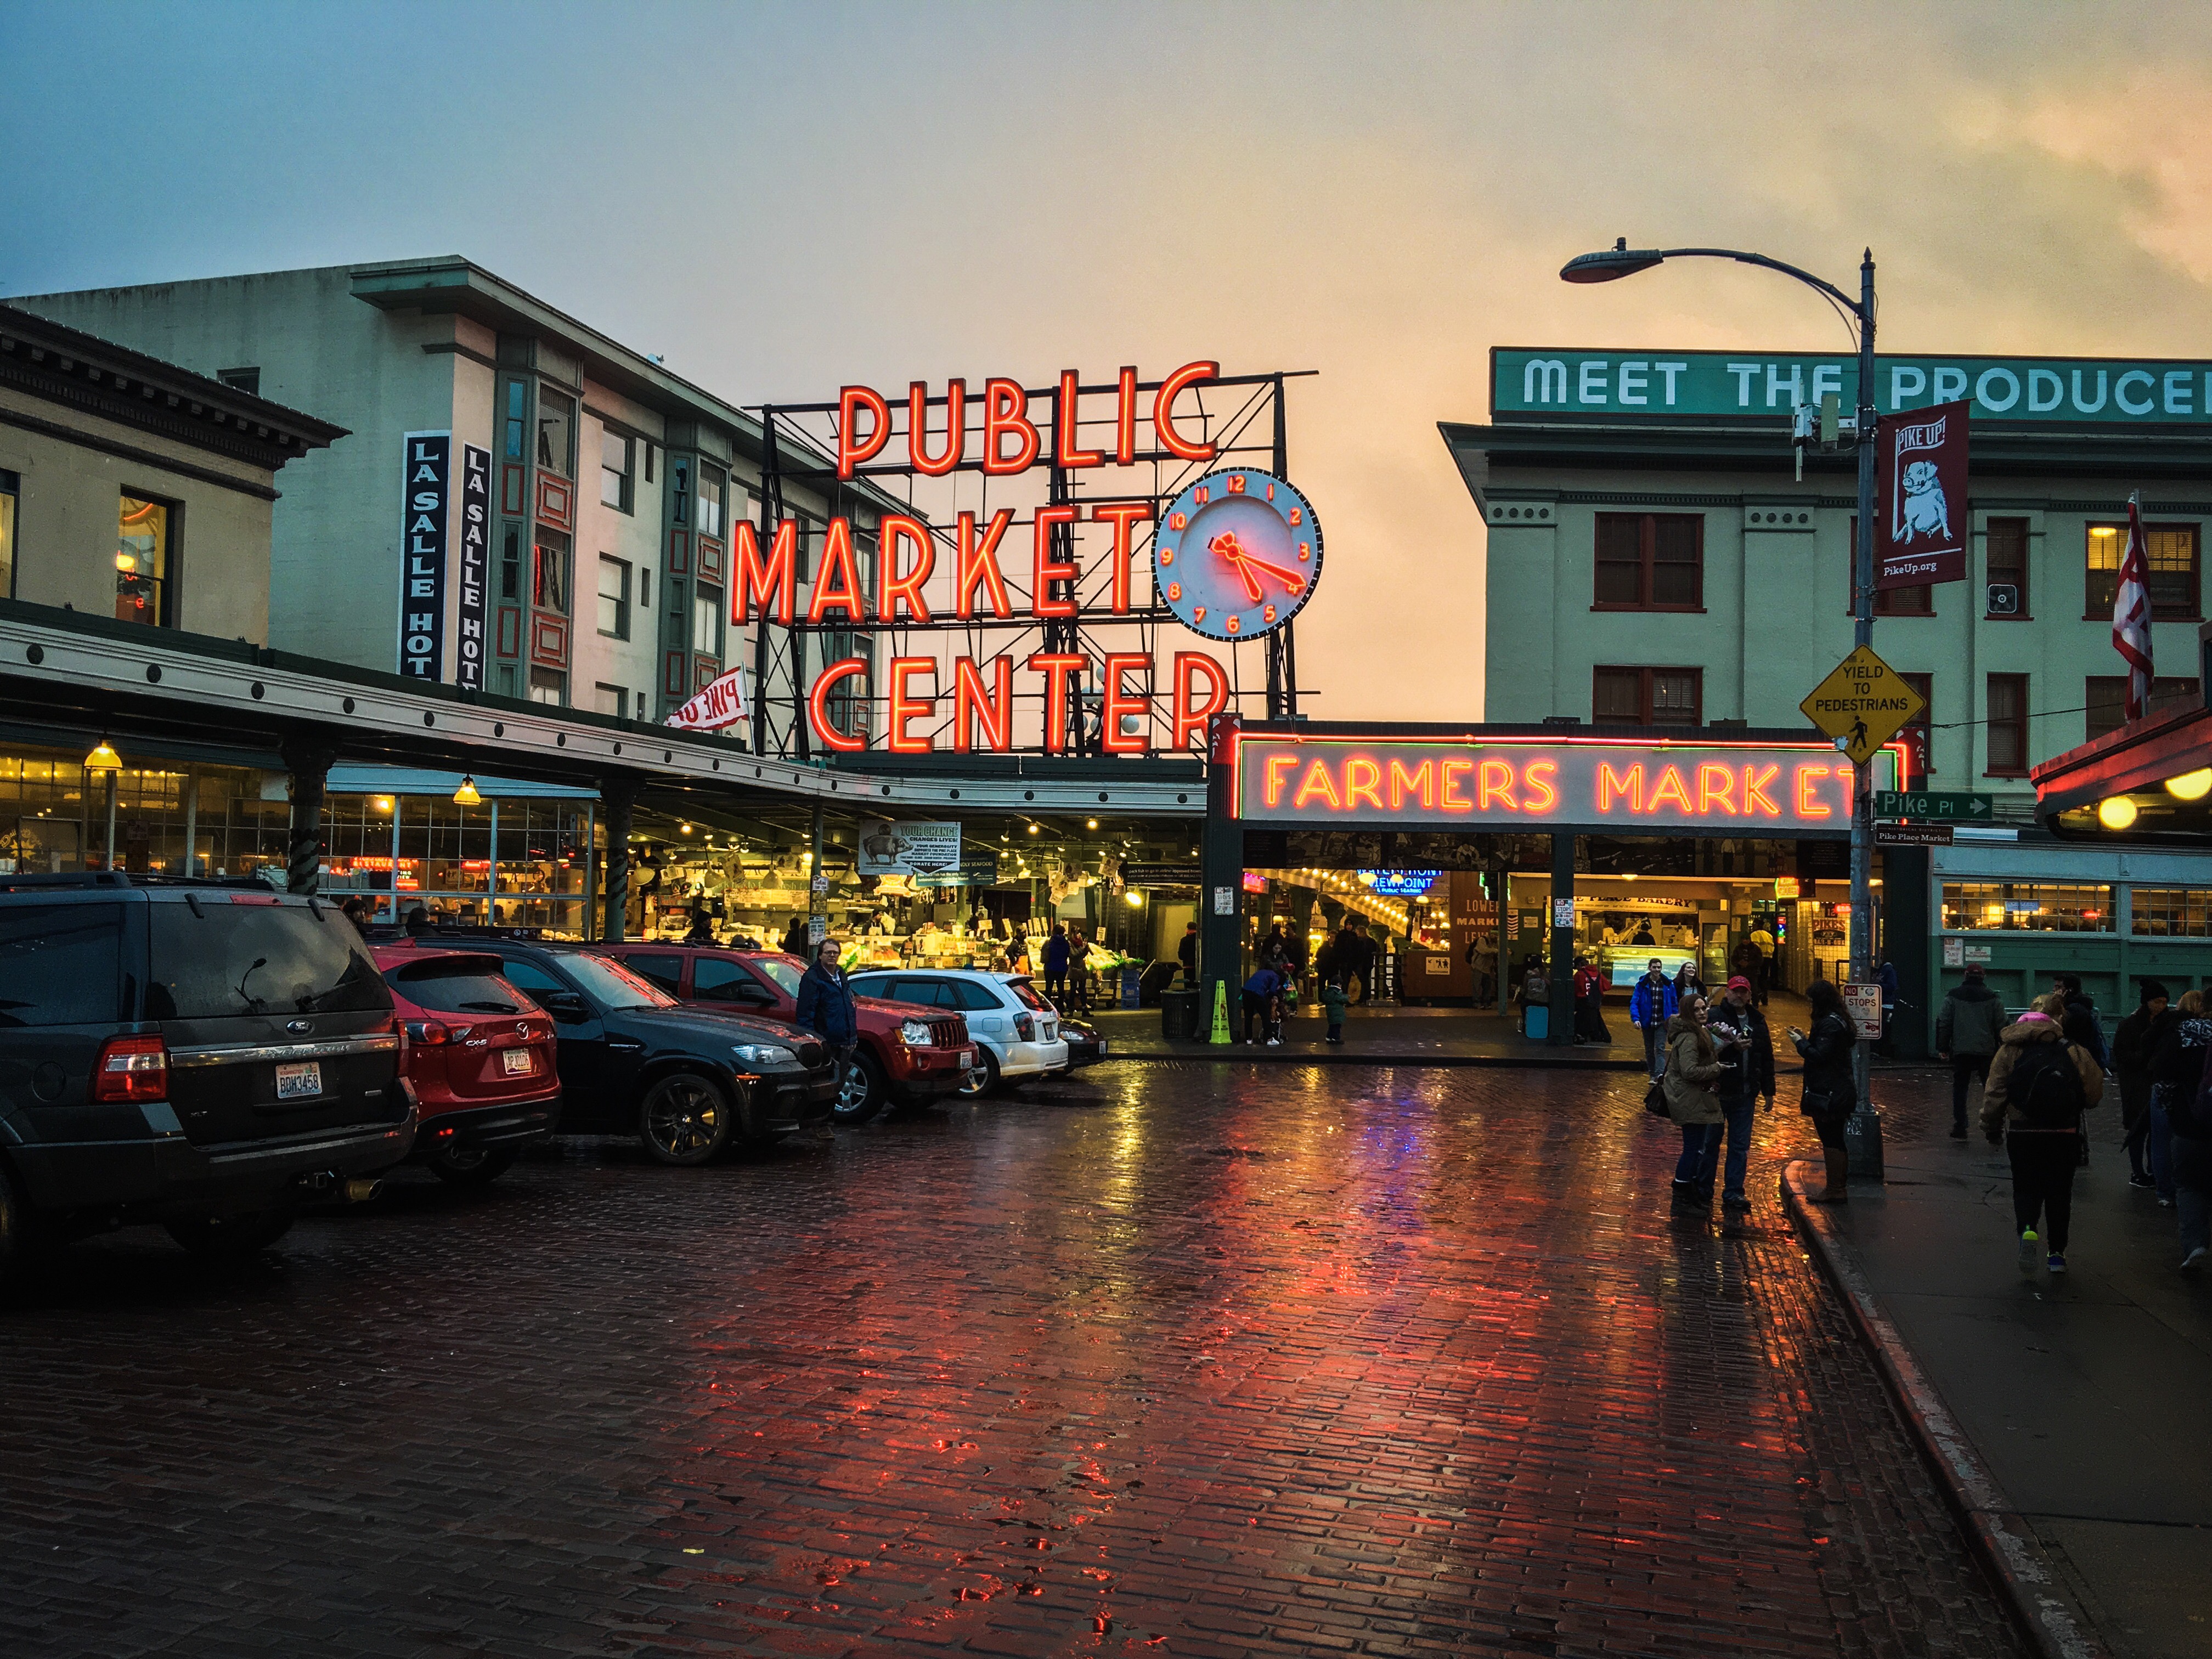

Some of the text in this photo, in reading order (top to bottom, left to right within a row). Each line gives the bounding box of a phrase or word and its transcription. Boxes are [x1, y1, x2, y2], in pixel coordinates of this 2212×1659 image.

[1523, 359, 2212, 415] MEET THE PRODUCE
[837, 361, 1220, 482] PUBLIC
[1898, 419, 1946, 452] PIKE UP!
[468, 450, 485, 494] LA
[1227, 476, 1245, 493] 12
[1266, 483, 1274, 501] 1
[1194, 486, 1209, 505] 11
[1169, 512, 1187, 531] 10
[1290, 506, 1302, 526] 2
[464, 504, 484, 607] SALLE
[1160, 547, 1174, 566] 9
[1298, 541, 1310, 562] 3
[407, 443, 439, 682] LA SALLE HOT
[732, 502, 1154, 626] MARKET
[1883, 562, 1937, 577] PikeUp.org
[1168, 582, 1182, 601] 8
[1193, 606, 1207, 624] 7
[1263, 604, 1277, 623] 5
[1226, 614, 1240, 634] 6
[1843, 665, 1884, 679] YIELD
[1854, 682, 1871, 695] TO
[810, 651, 1230, 755] CENTER
[1816, 698, 1908, 712] PEDESTRIANS
[1266, 756, 1557, 811] FARMERS
[1884, 793, 1954, 814] Pike Pl
[900, 826, 958, 837] YOUR CHANGE
[1638, 897, 1692, 908] BAKERY
[1457, 917, 1499, 926] MARK
[1848, 998, 1876, 1007] STOPS
[280, 1074, 319, 1093] BDH3458
